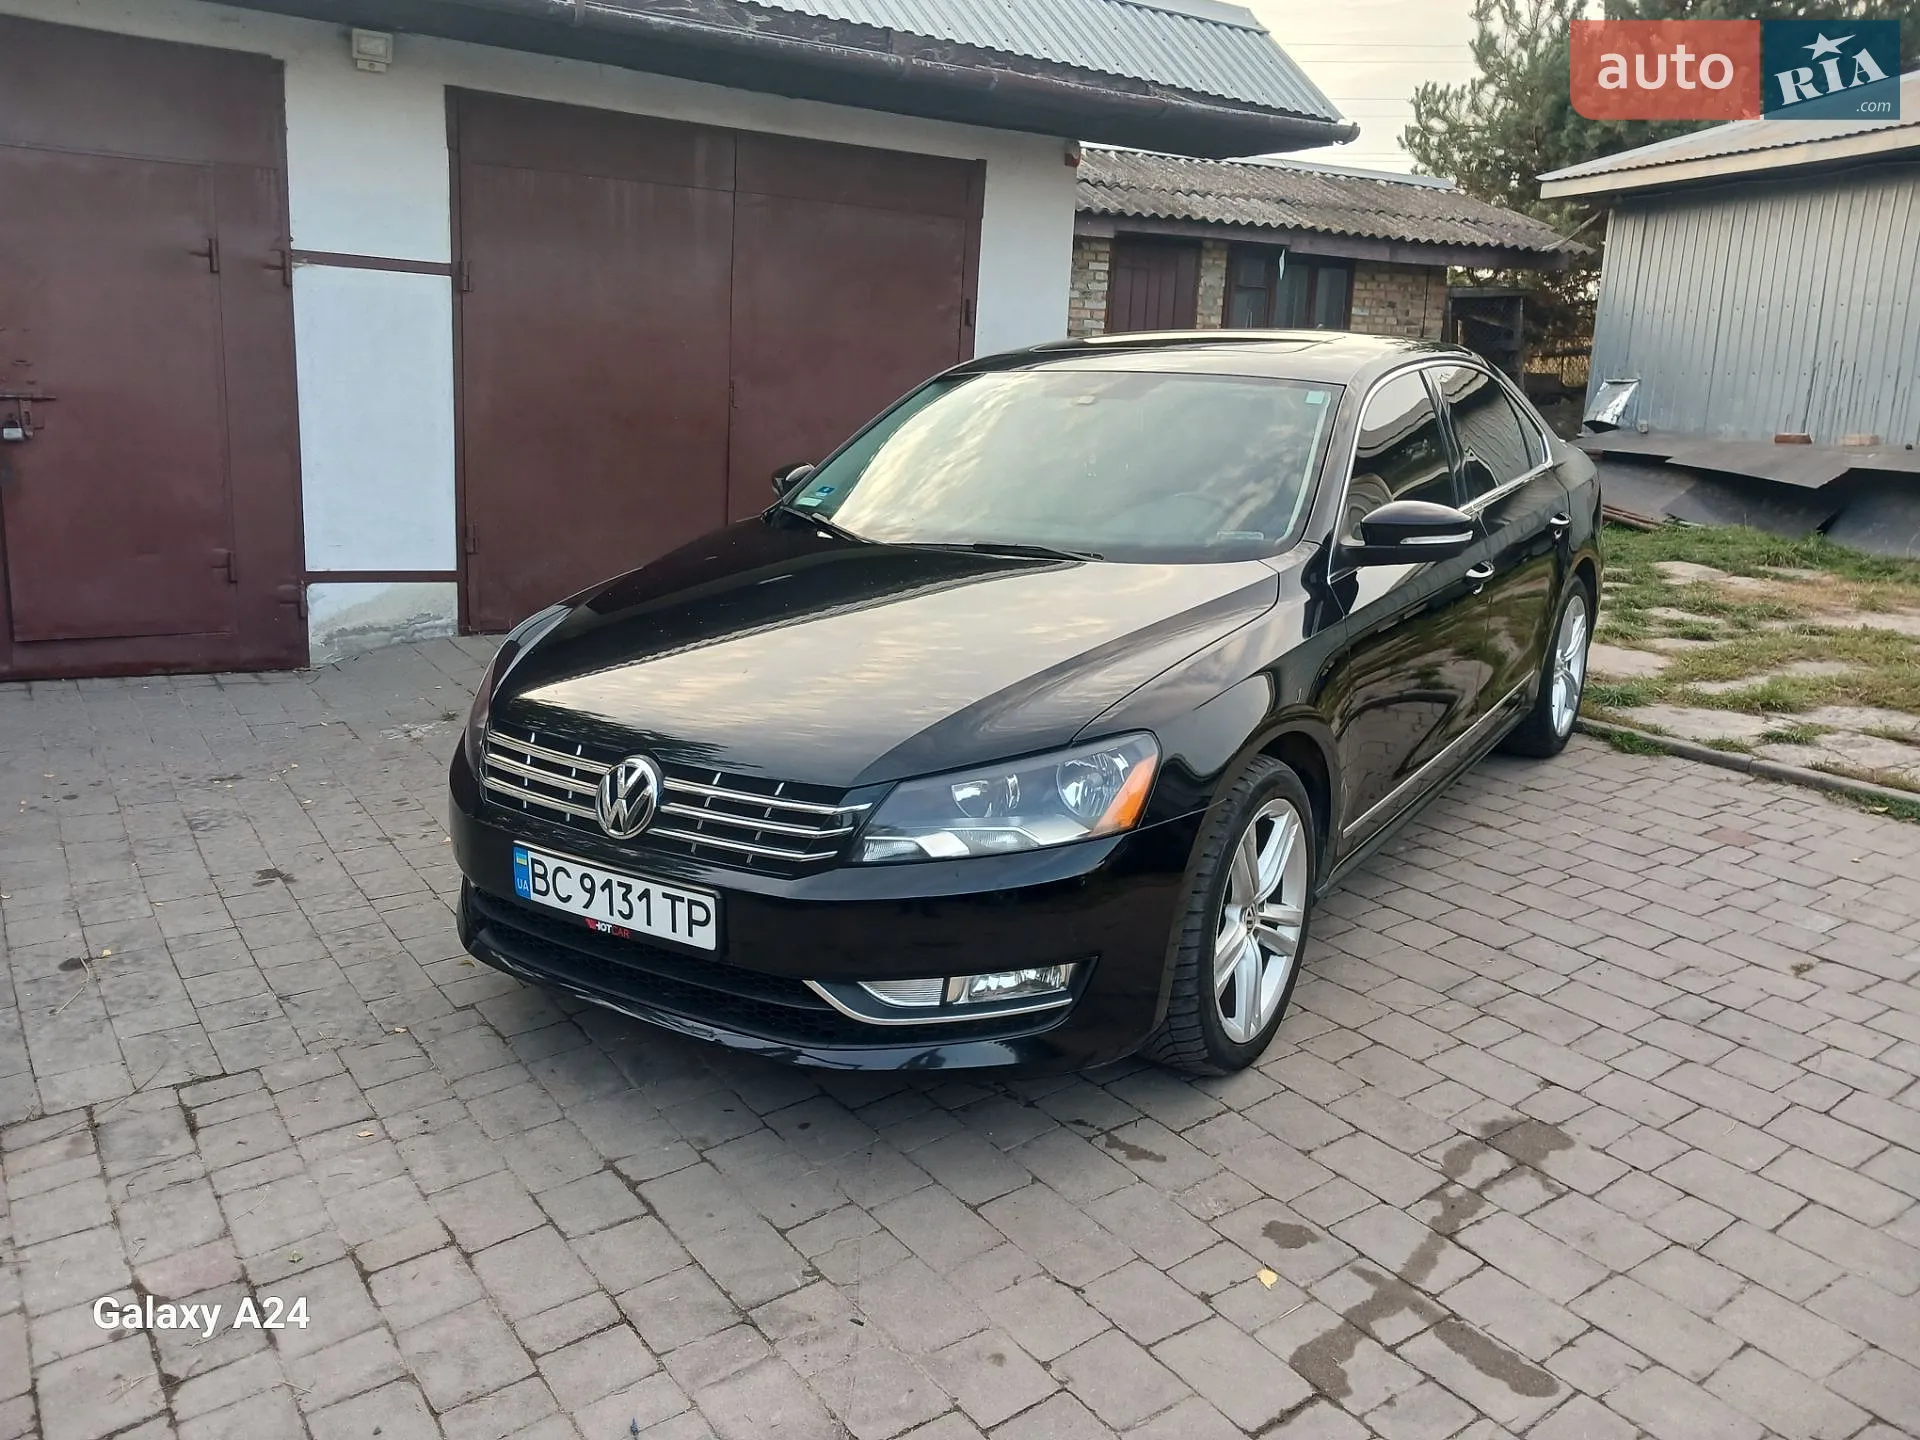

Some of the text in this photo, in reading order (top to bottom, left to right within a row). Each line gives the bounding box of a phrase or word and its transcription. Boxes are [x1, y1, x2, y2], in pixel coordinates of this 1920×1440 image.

[516, 879, 530, 892] UA
[530, 857, 712, 938] BC 9131 TP
